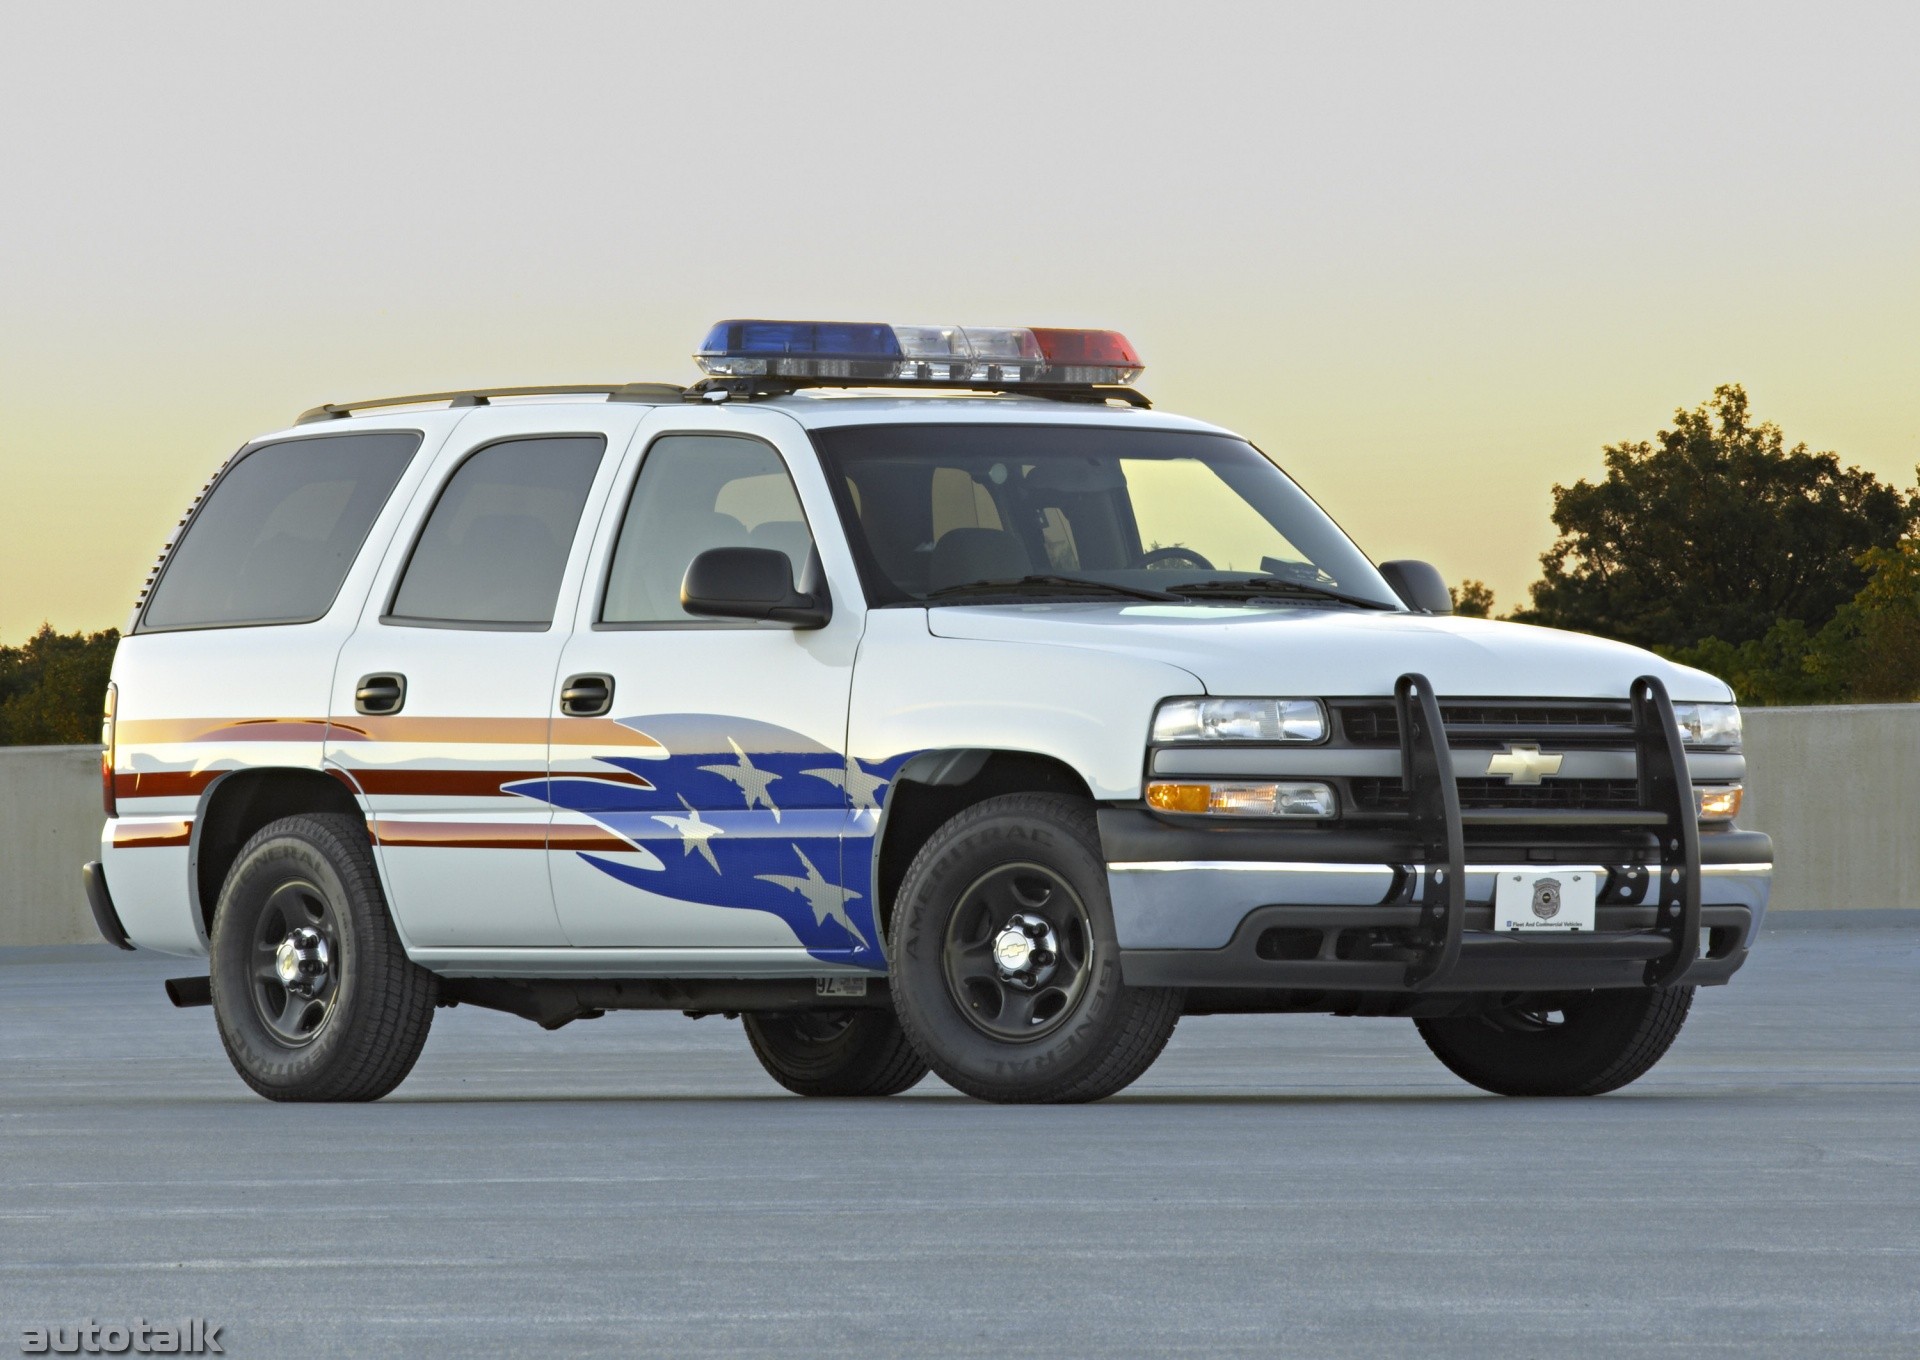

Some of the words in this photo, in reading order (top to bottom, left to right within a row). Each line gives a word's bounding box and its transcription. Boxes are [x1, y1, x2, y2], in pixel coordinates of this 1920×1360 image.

[230, 846, 326, 899] GENERAL
[906, 825, 1054, 960] AMERITRAC
[986, 959, 1112, 1074] GENERAL
